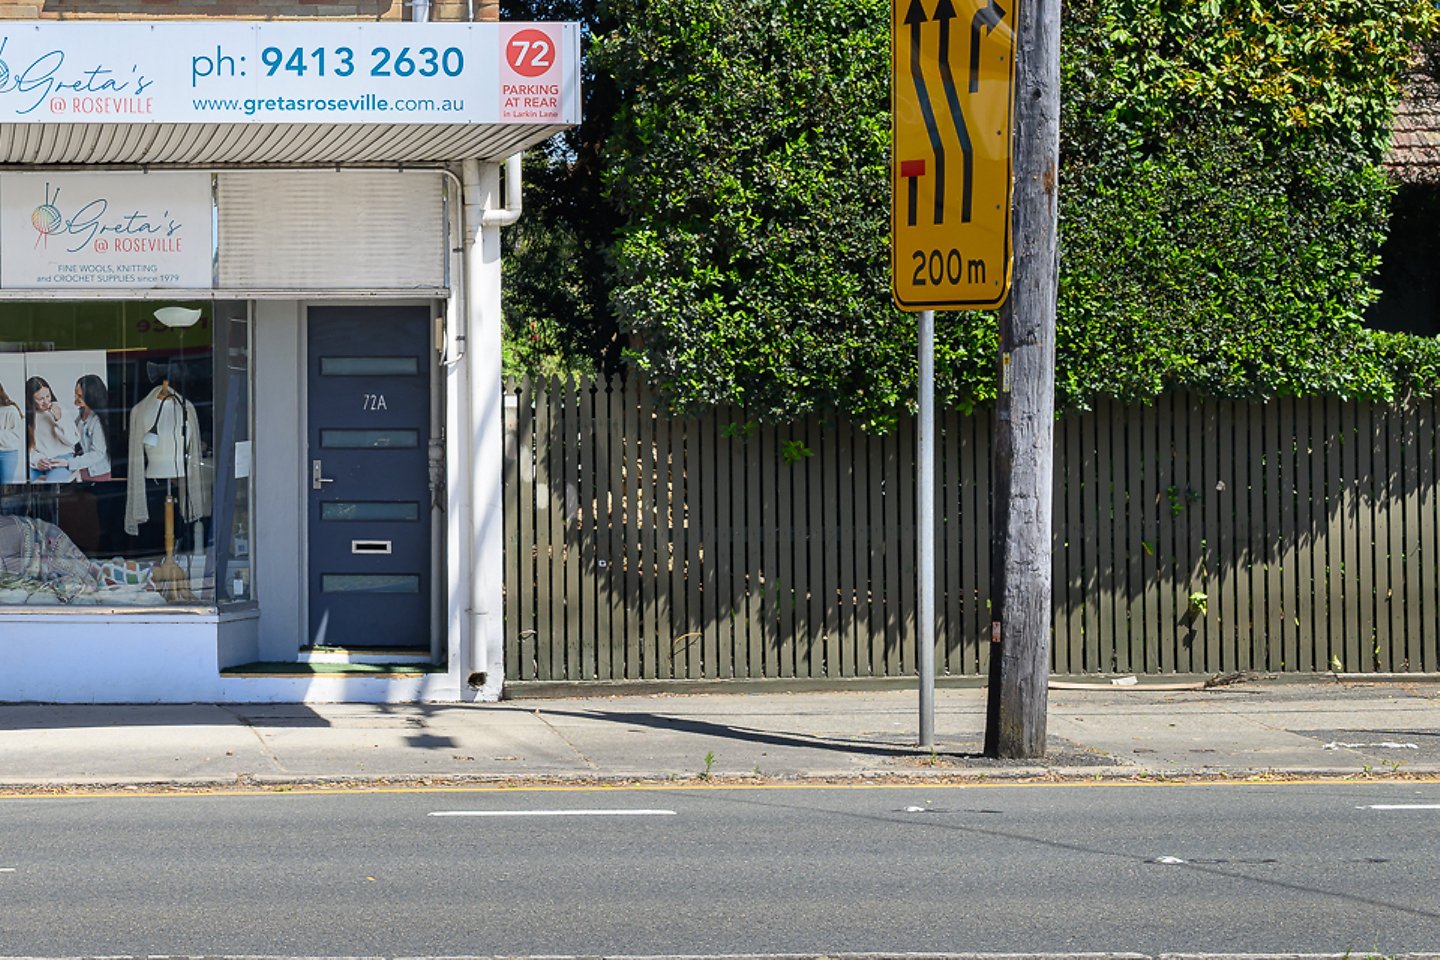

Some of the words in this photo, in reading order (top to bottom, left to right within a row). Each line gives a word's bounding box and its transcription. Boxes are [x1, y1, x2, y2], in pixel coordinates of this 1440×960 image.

[511, 40, 550, 67] 72
[192, 45, 247, 87] ph:
[261, 46, 355, 77] 9413
[370, 46, 464, 77] 2630
[14, 50, 154, 115] Greta's
[503, 85, 559, 95] PARKING
[50, 97, 67, 114] @
[72, 97, 153, 114] ROSEVILLE
[192, 94, 465, 115] www.gretasroseville.com.au
[504, 97, 520, 108] AT
[524, 97, 558, 108] REAR
[66, 198, 183, 253] Greta's
[93, 238, 109, 254] @
[114, 238, 182, 253] ROSEVILLE
[58, 264, 78, 273] FINE
[79, 264, 114, 274] WOOLS,
[116, 264, 158, 273] KNITTING
[36, 274, 52, 283] and
[53, 274, 95, 283] CROCHET
[96, 274, 136, 283] SUPPLIES
[137, 274, 158, 283] since
[159, 274, 180, 283] 1979
[363, 394, 388, 410] 72A
